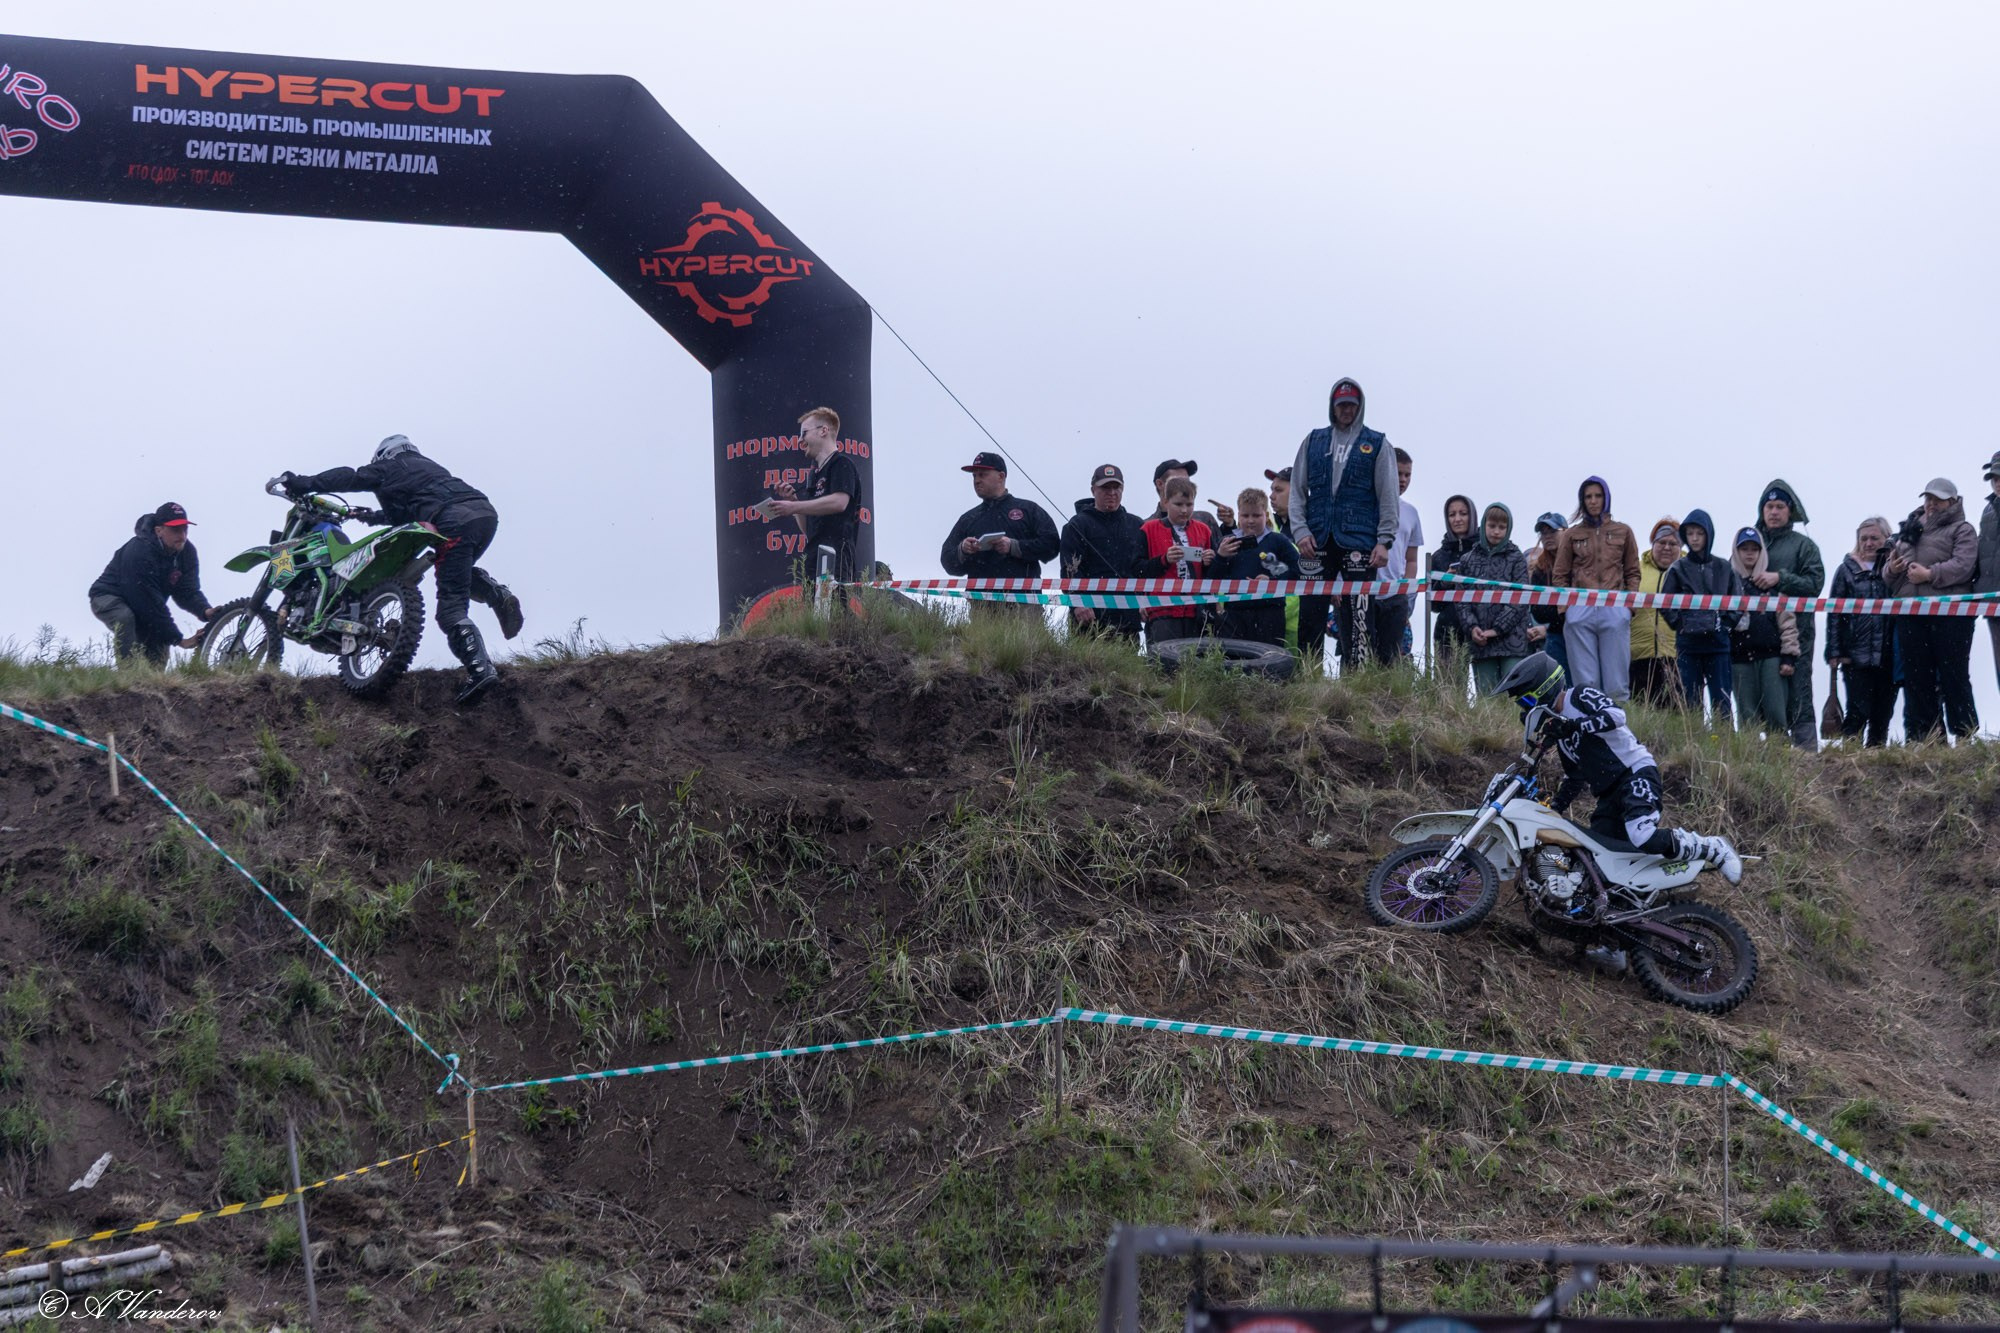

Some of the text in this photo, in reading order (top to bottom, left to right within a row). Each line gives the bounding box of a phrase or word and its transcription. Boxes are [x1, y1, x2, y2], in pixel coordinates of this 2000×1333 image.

[135, 64, 506, 117] HYPERCUT
[132, 106, 492, 146] ПРОИЗВОДИТЕЛЬ ПРОМЫШЛЕННЫХ
[186, 139, 439, 175] СИСТЕМ РЕЗКИ МЕТАЛЛА
[638, 254, 815, 277] HYPERCUT
